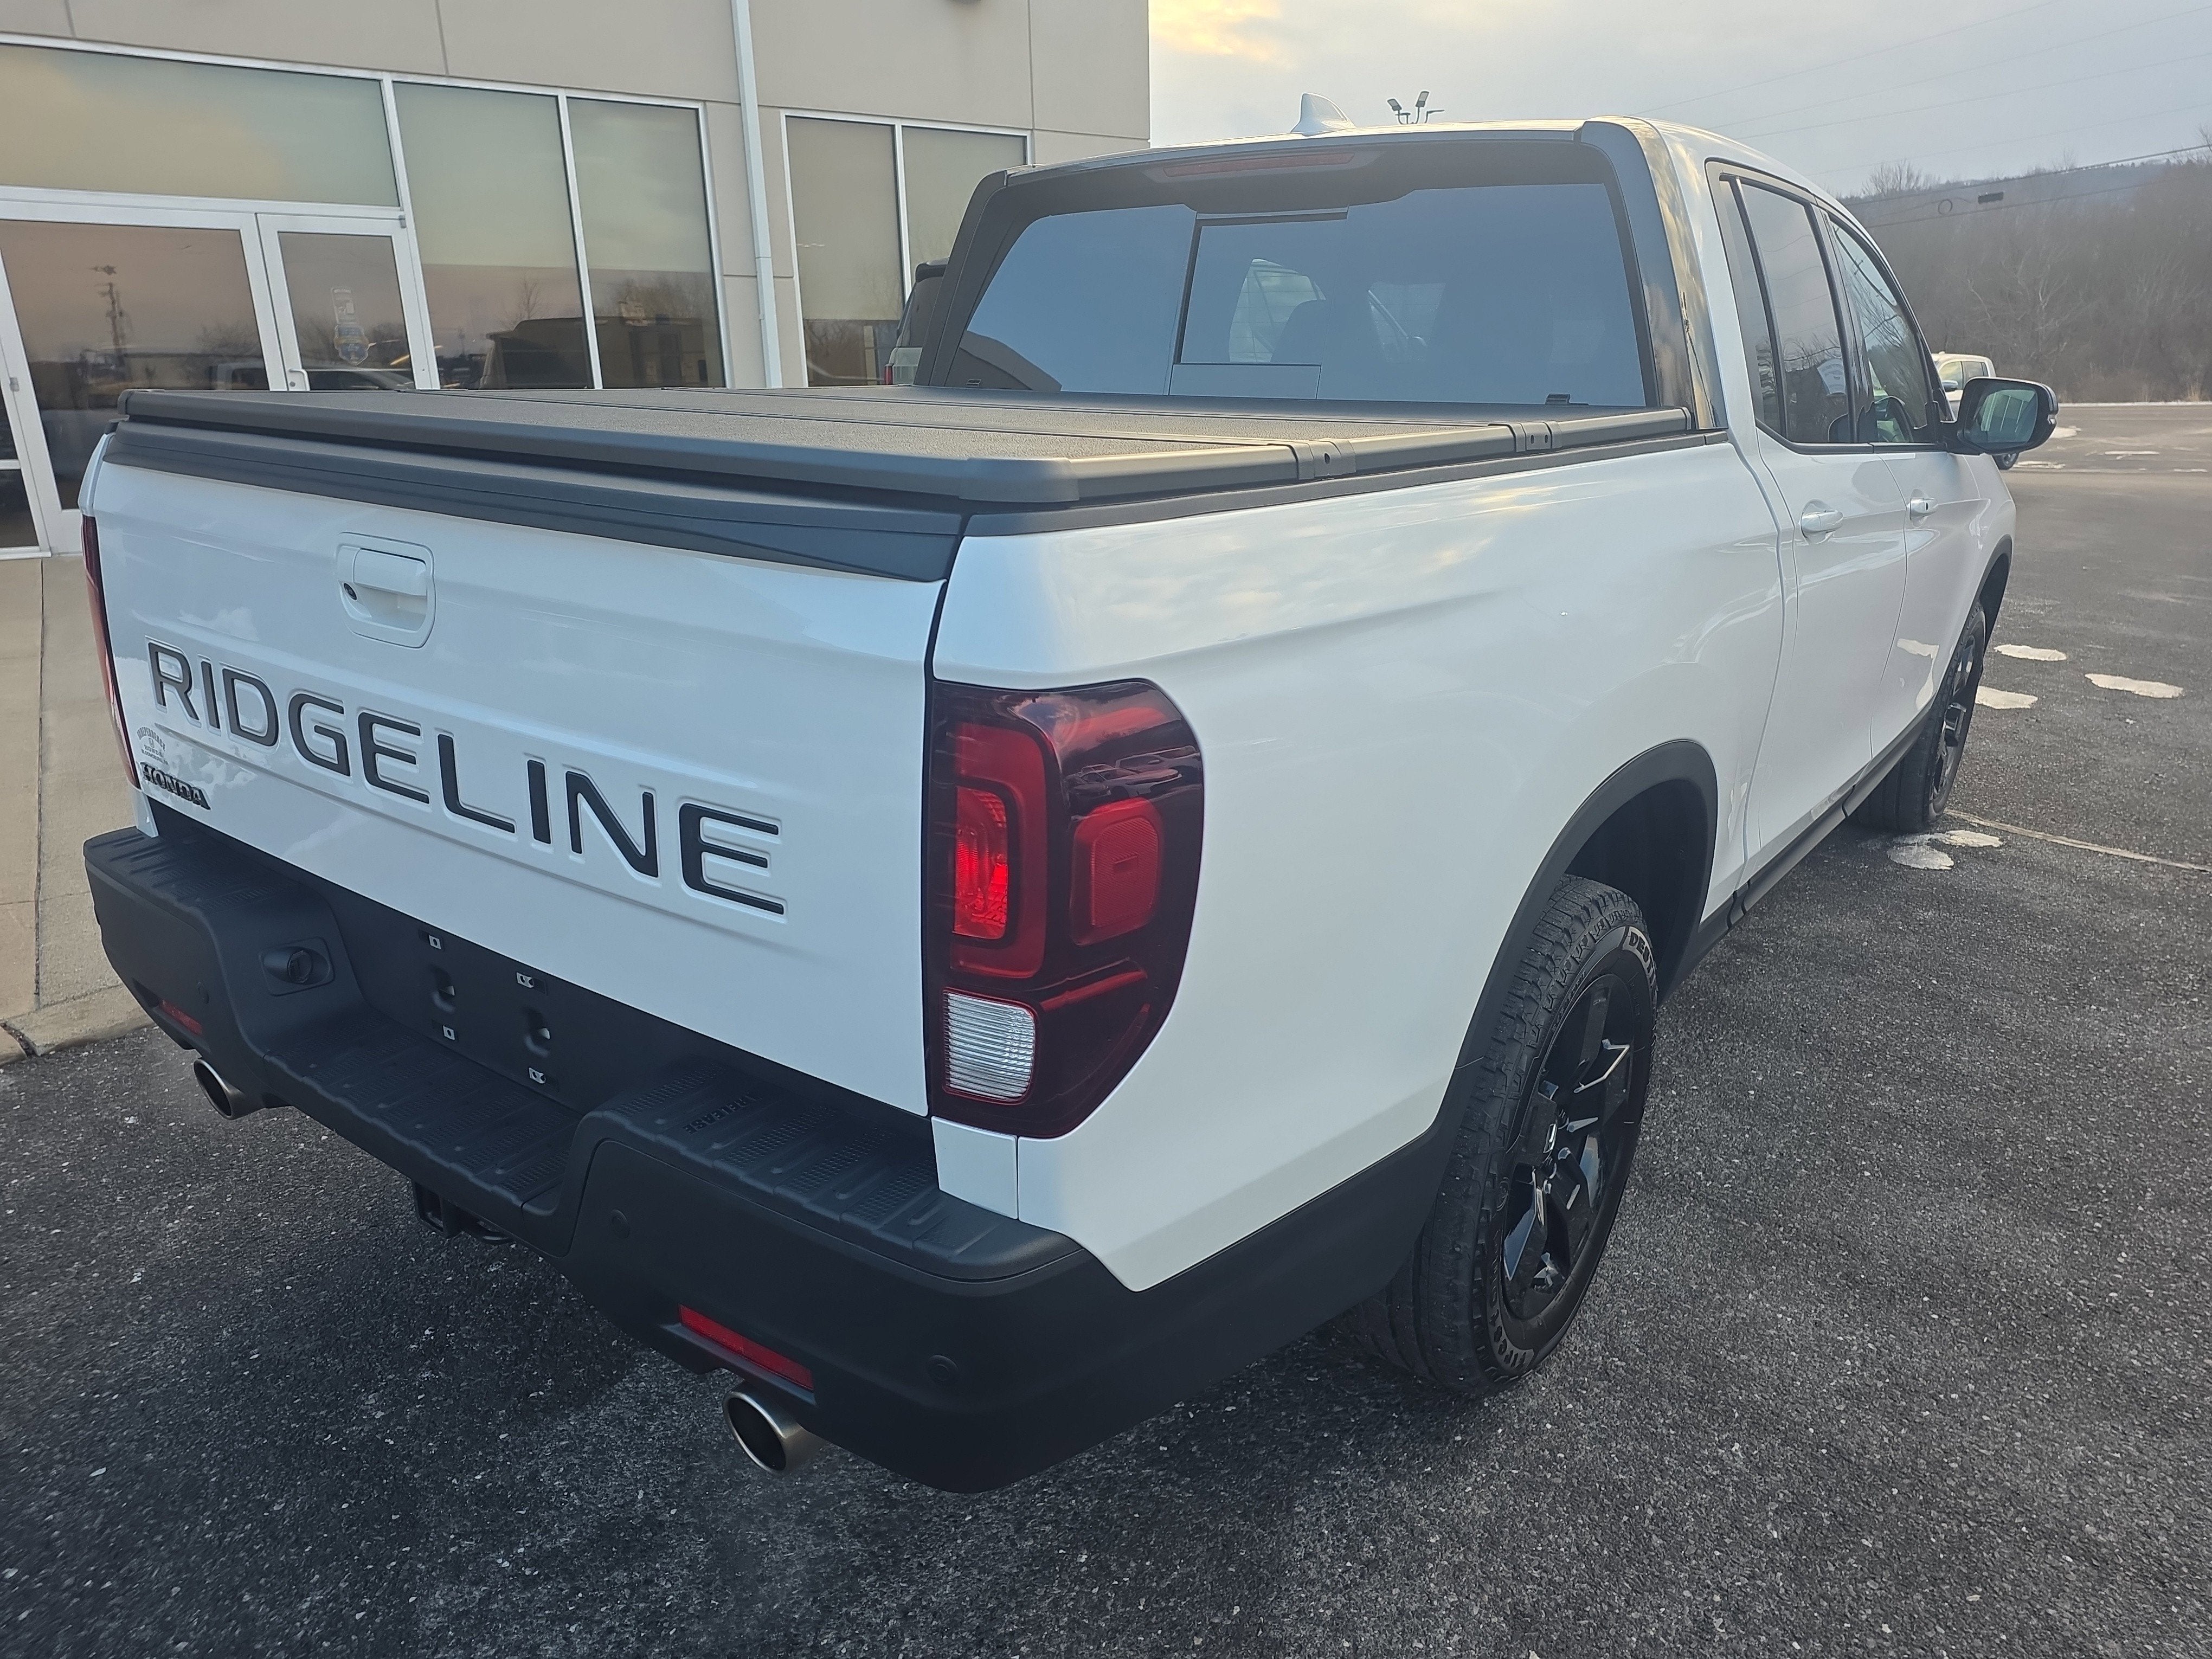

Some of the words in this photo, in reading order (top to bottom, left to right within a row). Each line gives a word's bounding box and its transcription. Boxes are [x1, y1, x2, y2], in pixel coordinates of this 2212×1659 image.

[140, 761, 211, 810] HONDA
[147, 640, 786, 917] RIDGELINE
[683, 1095, 750, 1135] RELEASE
